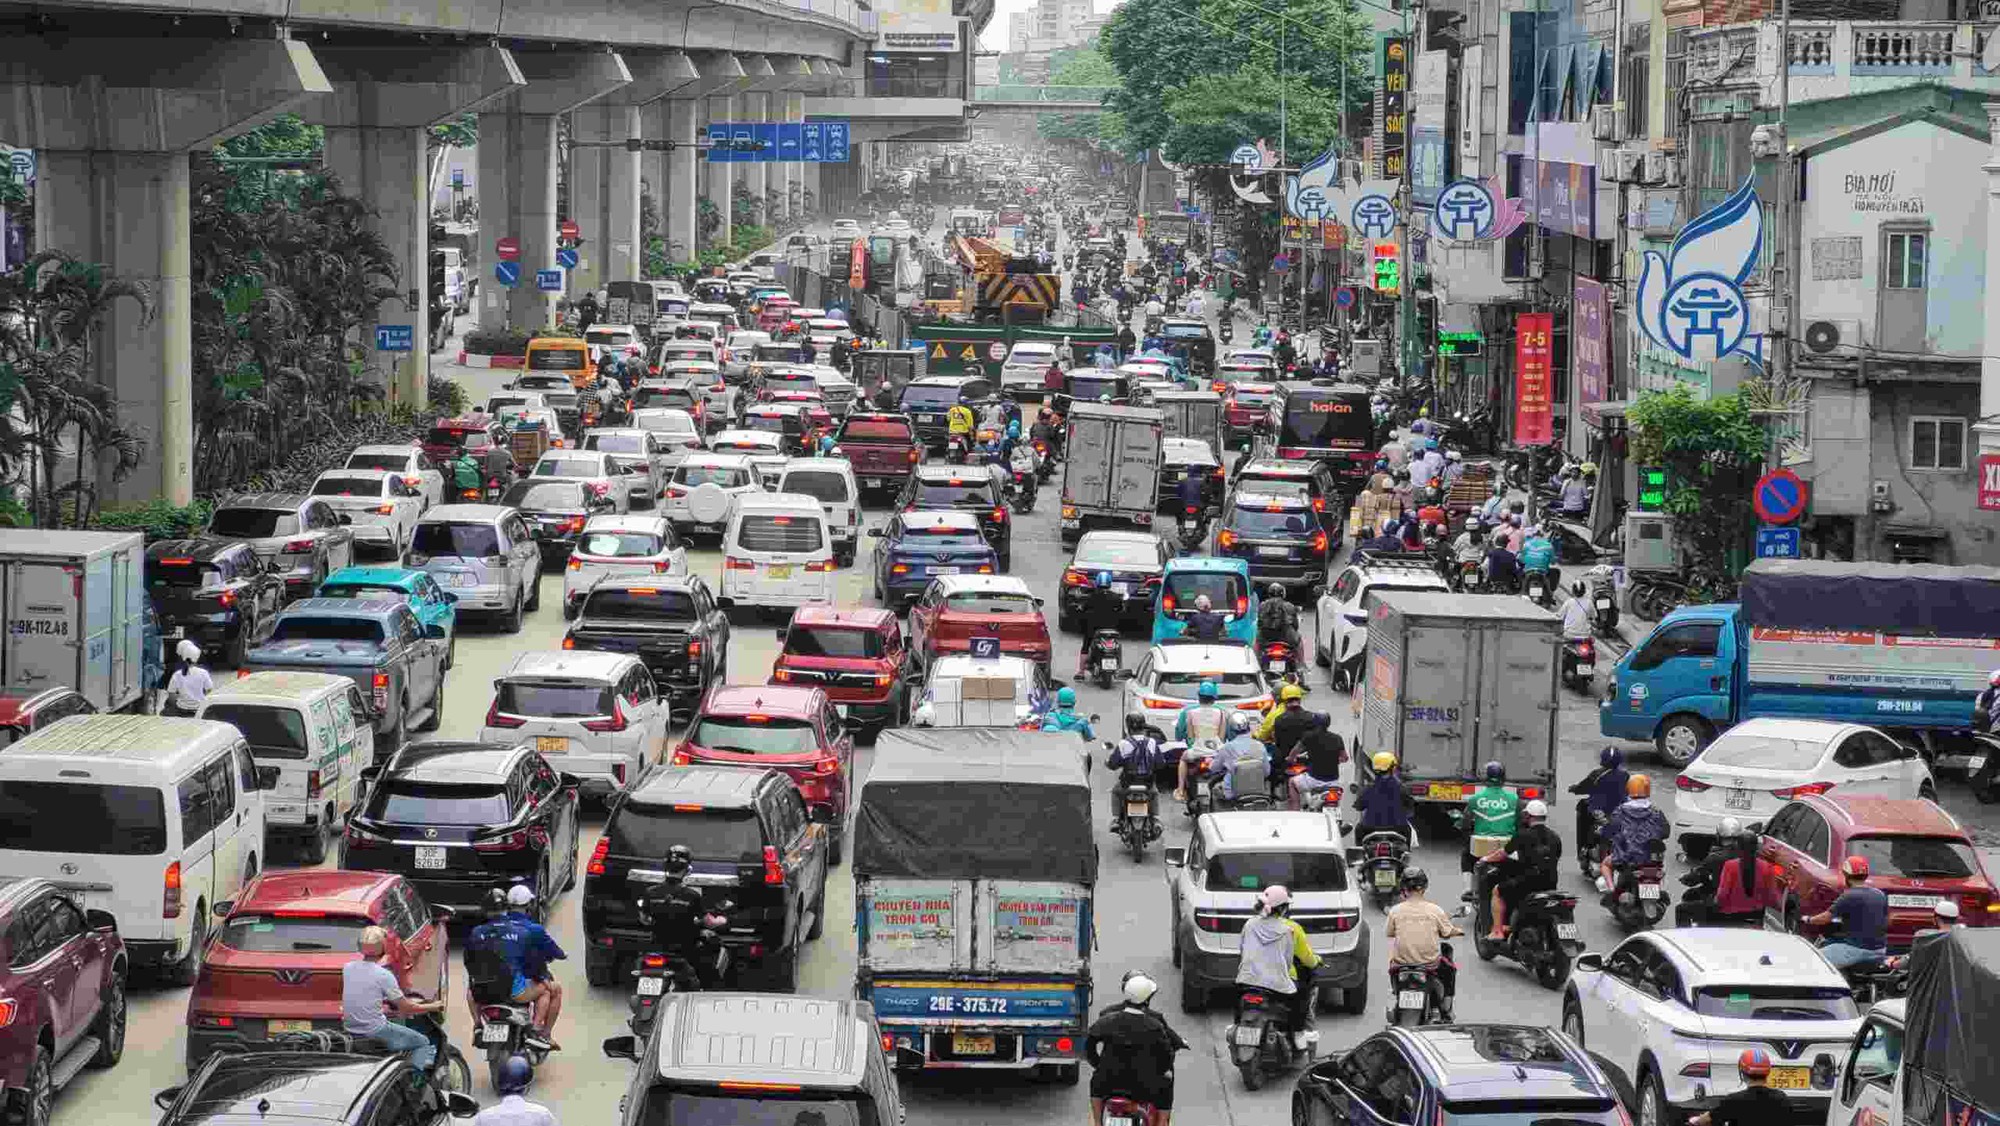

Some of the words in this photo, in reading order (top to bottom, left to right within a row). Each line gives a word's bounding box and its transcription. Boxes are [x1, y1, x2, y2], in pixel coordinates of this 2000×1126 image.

[1844, 174, 1866, 194] BIA
[1522, 332, 1546, 347] 7-5
[1476, 798, 1508, 811] Grab
